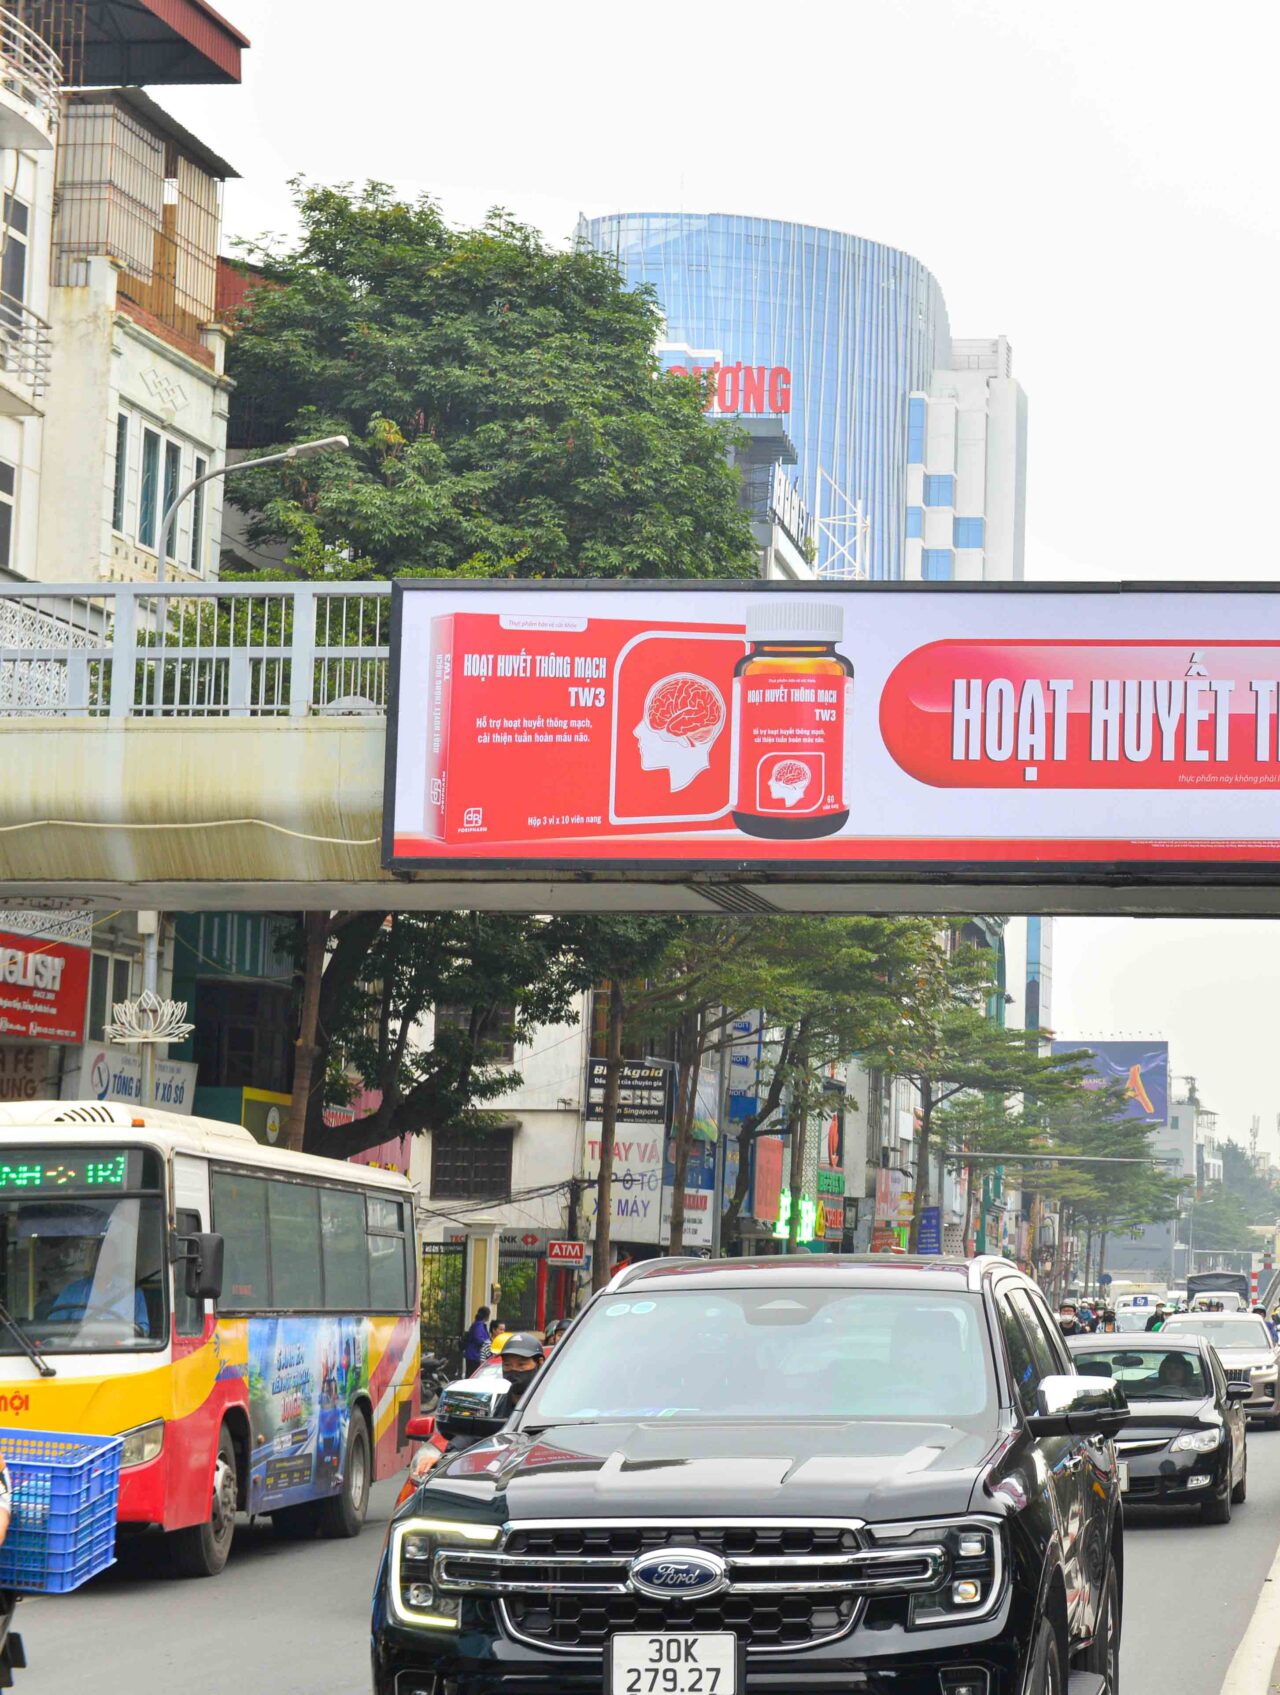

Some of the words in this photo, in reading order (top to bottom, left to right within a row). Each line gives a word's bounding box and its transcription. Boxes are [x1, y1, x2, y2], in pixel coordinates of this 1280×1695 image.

[464, 653, 493, 682] HOẠT
[497, 648, 532, 678] HUYẾT
[536, 652, 571, 679] THÔNG
[574, 656, 607, 683] MẠCH
[568, 687, 606, 707] TW3
[747, 690, 764, 706] HOẠT
[765, 684, 788, 703] HUYẾT
[790, 686, 816, 703] THÔNG
[817, 690, 837, 706] MẠCH
[476, 715, 487, 728] Hỗ
[489, 717, 501, 729] trợ
[503, 717, 521, 730] hoạt
[523, 715, 544, 729] huyết
[546, 717, 568, 729] thông
[570, 718, 592, 729] mạch,
[814, 709, 836, 721] TW3
[952, 677, 1074, 781] HOẠT
[1090, 651, 1235, 762] HUYẾT
[477, 732, 490, 744] cải
[492, 732, 512, 745] thiện
[515, 730, 532, 743] tuần
[535, 731, 553, 743] hoàn
[556, 732, 571, 743] máu
[574, 732, 590, 743] não.
[1178, 774, 1196, 783] thực
[1197, 774, 1218, 785] phẩm
[1219, 775, 1234, 785] này
[1235, 774, 1258, 785] không
[1259, 774, 1277, 785] phải
[528, 816, 540, 830] Hộp
[543, 815, 547, 824] 3
[562, 815, 570, 824] 10
[571, 814, 585, 824] viên
[586, 815, 602, 825] nang
[636, 1139, 660, 1164] VÁ
[617, 1195, 650, 1218] MÁY
[552, 1244, 581, 1257] ATM
[653, 1563, 700, 1585] Ford
[648, 1638, 699, 1663] 30K
[626, 1668, 721, 1693] 279.27
